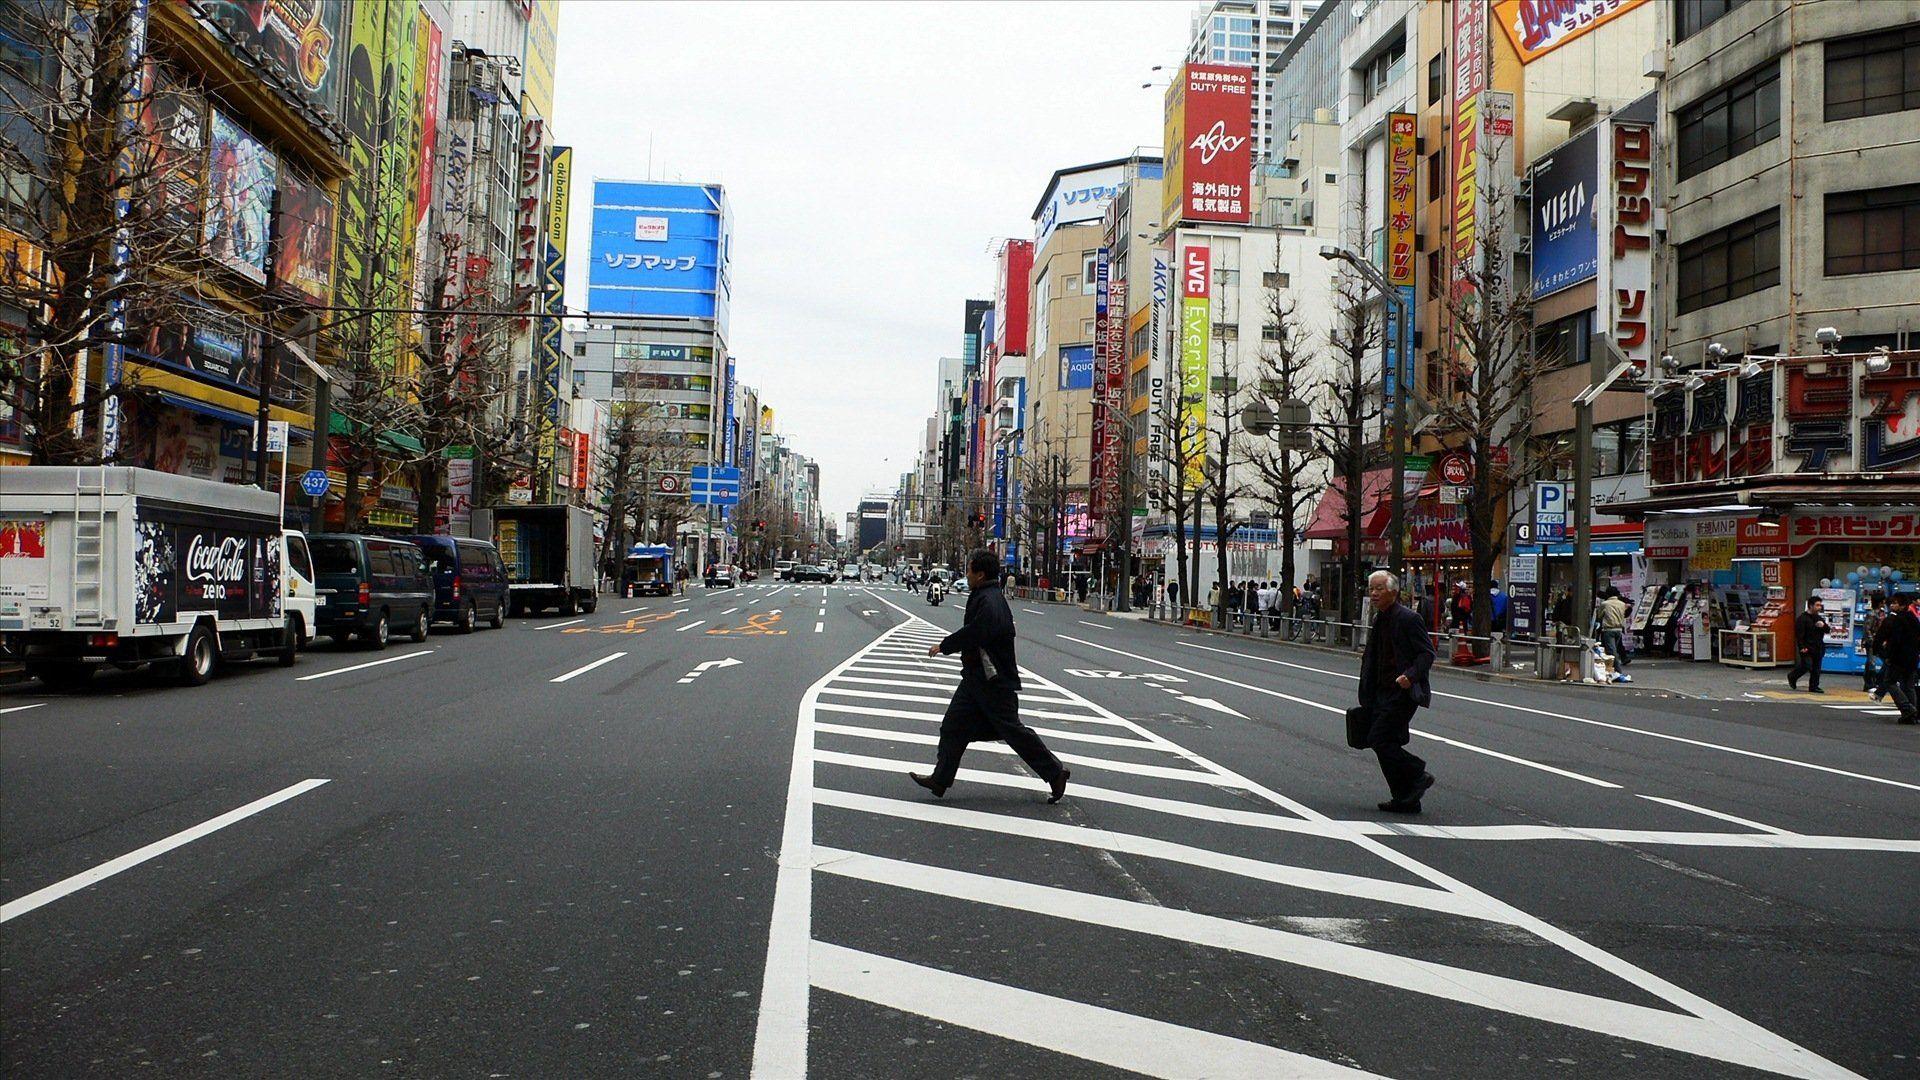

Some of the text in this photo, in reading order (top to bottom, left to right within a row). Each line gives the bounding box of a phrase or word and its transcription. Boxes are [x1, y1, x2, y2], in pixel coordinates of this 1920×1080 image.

[1190, 71, 1246, 84] 秋葉原免税中心
[1190, 82, 1246, 94] DUTY FREE
[1189, 127, 1247, 159] AKKY
[1456, 93, 1477, 259] ラムタラ
[1192, 182, 1242, 198] 海外向け
[553, 163, 566, 239] akibakan.com
[1192, 199, 1242, 214] 電気製品
[605, 253, 696, 271] ソフマップ
[1187, 252, 1205, 294] JVC
[1151, 258, 1167, 361] AKKY INTERNATIONAL
[651, 349, 681, 358] FMV
[1187, 304, 1206, 389] Everio
[1151, 378, 1163, 417] DUTY
[1149, 424, 1161, 462] FREE
[303, 477, 325, 488] 437
[663, 480, 674, 489] 50
[1541, 486, 1560, 511] P
[1537, 514, 1563, 523] ダイビル
[1537, 525, 1551, 537] IN
[1745, 524, 1761, 537] au
[187, 533, 248, 582] Coca-Cola
[1764, 567, 1777, 577] au
[202, 584, 226, 600] zero
